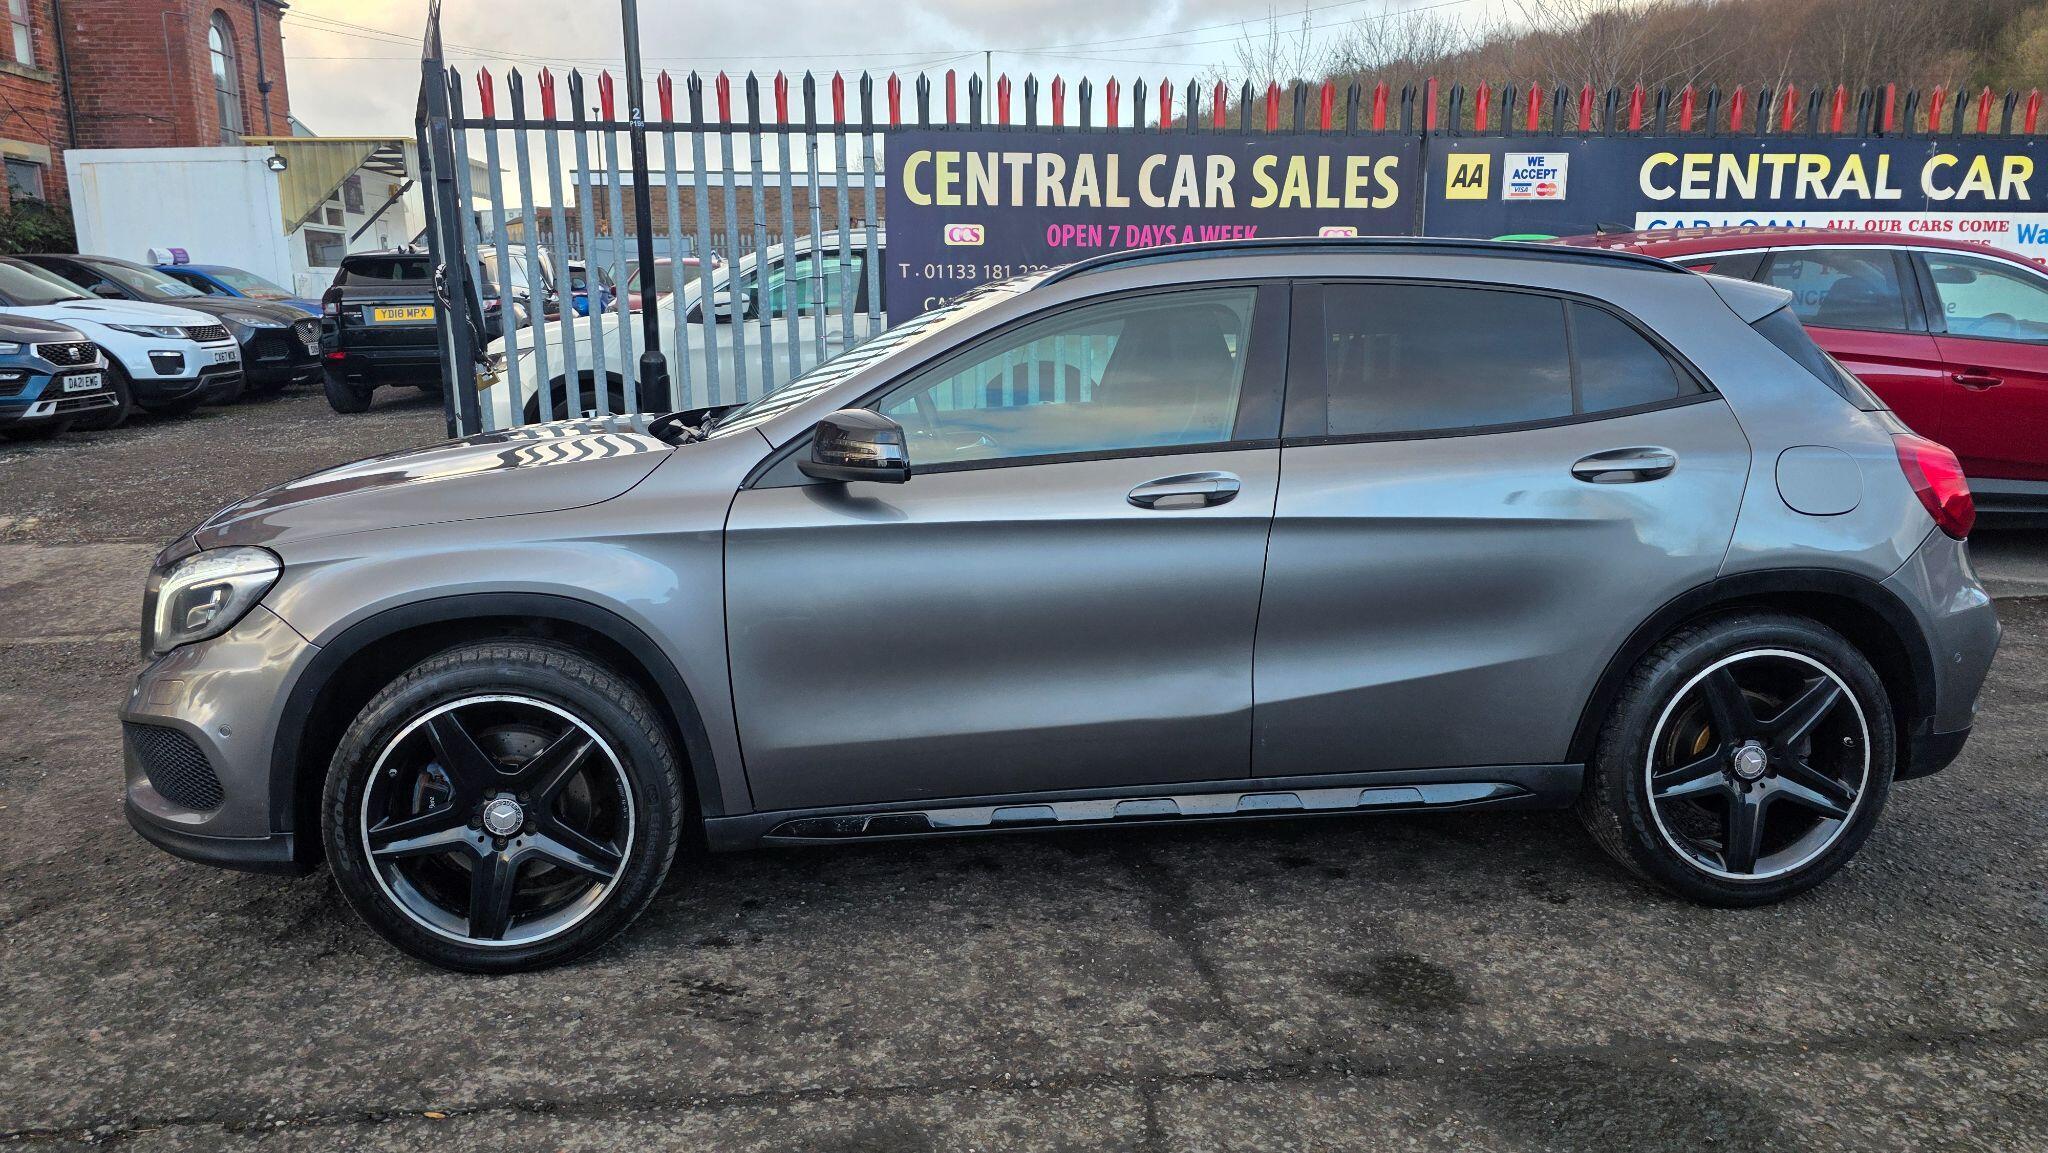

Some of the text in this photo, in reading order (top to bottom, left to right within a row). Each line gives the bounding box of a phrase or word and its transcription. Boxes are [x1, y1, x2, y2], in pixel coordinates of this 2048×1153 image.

[632, 107, 640, 120] 2
[1528, 156, 1545, 167] WE
[903, 150, 1399, 209] CENTRAL CAR SALES
[1451, 164, 1484, 188] AA
[1512, 169, 1558, 180] ACCEPT
[1639, 152, 2034, 201] CENTRAL CAR
[1826, 220, 2010, 233] ALL OUR CARS COME
[1047, 224, 1258, 248] OPEN 7 DAYS A WEEK
[924, 263, 976, 279] 01133
[983, 264, 1011, 278] 181
[382, 308, 404, 319] YD18
